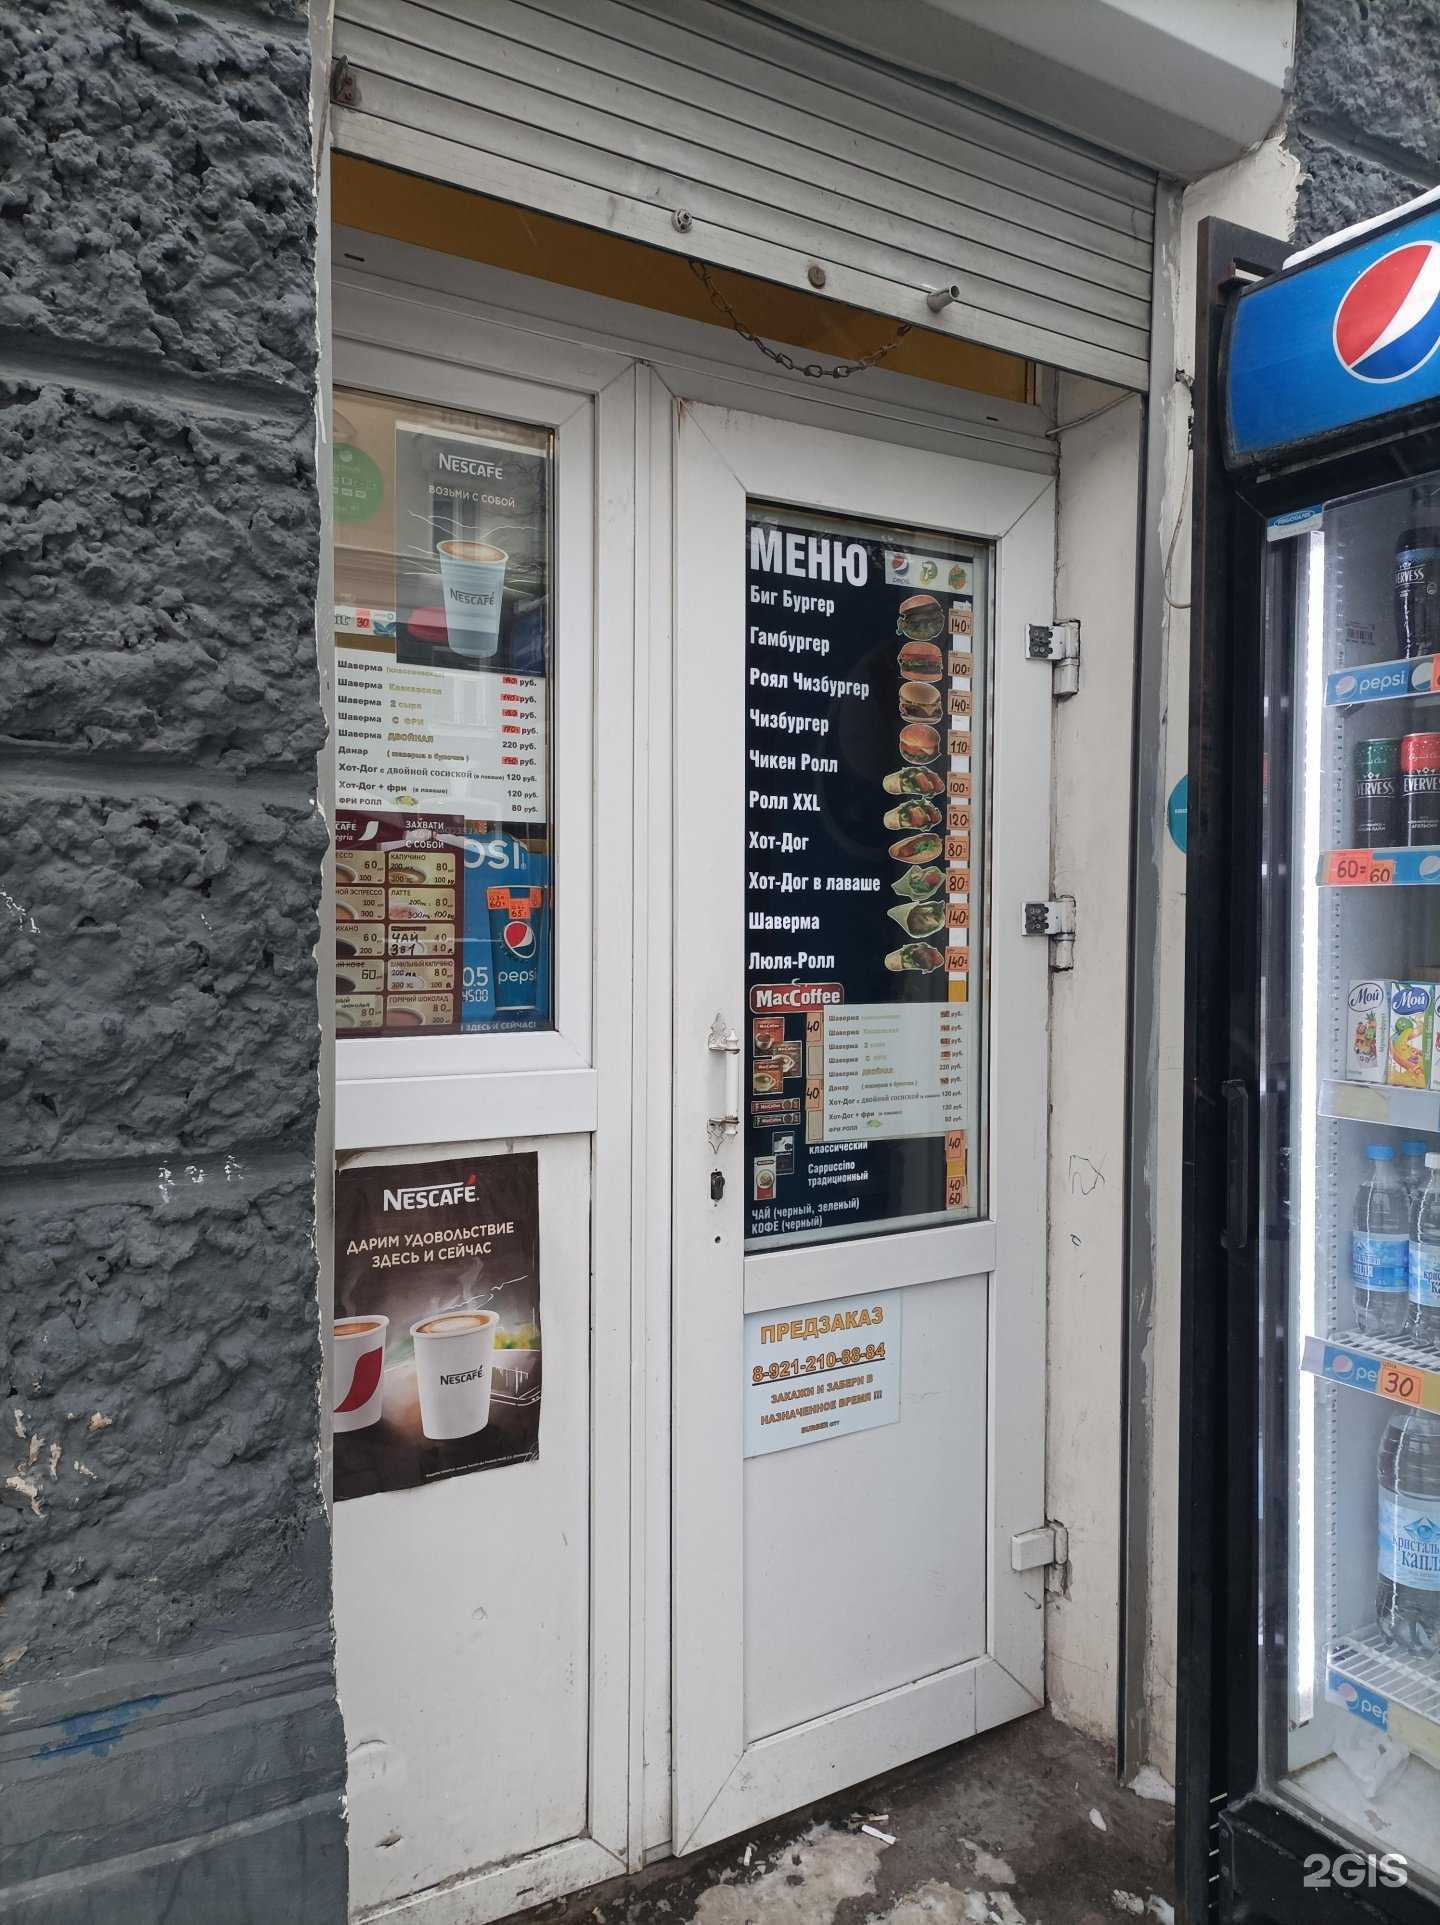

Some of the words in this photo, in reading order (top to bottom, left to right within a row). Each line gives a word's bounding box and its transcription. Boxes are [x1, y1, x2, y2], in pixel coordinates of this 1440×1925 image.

[428, 485, 469, 499] ВОЗЬМИ
[480, 494, 515, 508] СОБОЙ
[750, 527, 868, 587] МЕНЮ
[750, 585, 778, 605] Биг
[783, 590, 835, 616] Бургер
[750, 626, 830, 656] Гамбургер
[338, 660, 383, 672] Шаверма
[338, 678, 383, 690] Шаверма
[750, 667, 788, 689] Роял
[794, 672, 870, 700] Чизбургер
[1359, 671, 1405, 695] pepsi
[338, 695, 382, 707] Шаверма
[338, 712, 382, 724] Шаверма
[750, 709, 829, 736] Чизбургер
[338, 729, 382, 740] Шаверма
[339, 763, 378, 774] Хот-Дог
[750, 750, 796, 770] Чикен
[801, 753, 838, 773] Ролл
[339, 781, 376, 791] Хот-Дог
[387, 783, 407, 792] фри
[750, 791, 788, 810] Ролл
[793, 793, 821, 812] XXL
[406, 821, 444, 830] ЗАХВАТИ
[749, 832, 809, 853] Хот-Дог
[749, 872, 809, 893] Хот-Дог
[814, 878, 822, 890] в
[826, 877, 881, 892] лаваше
[1370, 868, 1391, 883] 60
[749, 912, 820, 934] Шаверма
[749, 952, 835, 970] Люля-Ролл
[756, 988, 841, 1008] MacCoffee
[1350, 987, 1379, 1007] Мой
[1393, 990, 1425, 1010] Мой
[808, 1160, 855, 1176] Cappuccino
[808, 1171, 869, 1188] традиционный
[751, 1207, 771, 1220] ЧАЙ
[751, 1220, 779, 1235] КОФЕ
[781, 1215, 823, 1232] (черный)
[346, 1234, 400, 1256] ДАРИМ
[404, 1221, 515, 1249] УДОВОЛЬСТВИЕ
[371, 1253, 420, 1269] ЗДЕСЬ
[424, 1251, 434, 1263] И
[438, 1241, 492, 1263] СЕЙЧАС
[760, 1306, 884, 1345] ПРЕДЗАКАЗ
[752, 1342, 886, 1383] 8-921-210-88-84
[771, 1387, 815, 1404] ЗАКАЖИ
[826, 1376, 865, 1392] ЗАБЕРИ
[1385, 1372, 1414, 1398] 30
[760, 1400, 837, 1426] НАЗНАЧЕННОЕ
